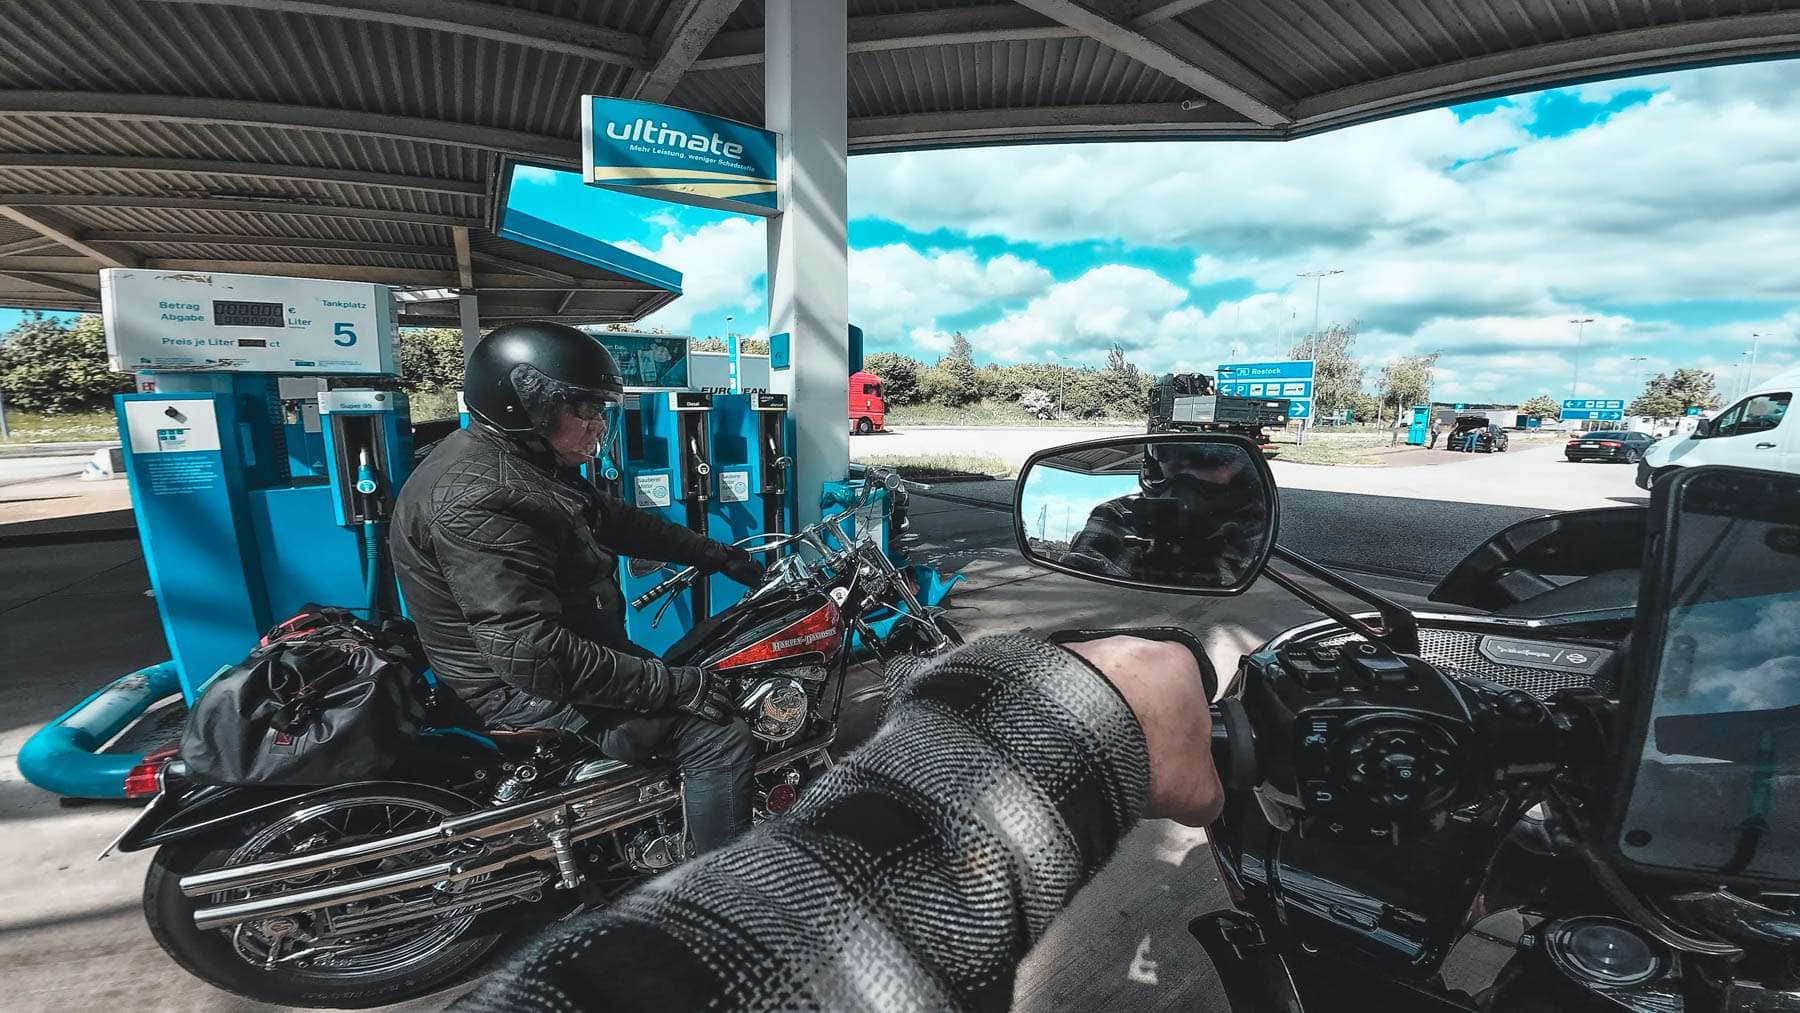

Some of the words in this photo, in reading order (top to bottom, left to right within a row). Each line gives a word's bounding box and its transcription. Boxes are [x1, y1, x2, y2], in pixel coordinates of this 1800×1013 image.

[607, 118, 743, 160] ultimate
[629, 144, 650, 154] Mehr
[652, 147, 687, 159] Leistung,
[688, 154, 717, 164] weniger
[159, 301, 200, 312] Betrag
[322, 300, 368, 310] Tankplatz
[160, 313, 205, 322] Abgabe
[288, 318, 312, 327] Liter
[334, 322, 357, 347] 5
[162, 337, 192, 346] Preis
[194, 338, 205, 348] je
[208, 338, 234, 346] Liter
[701, 386, 767, 395] EUREAN
